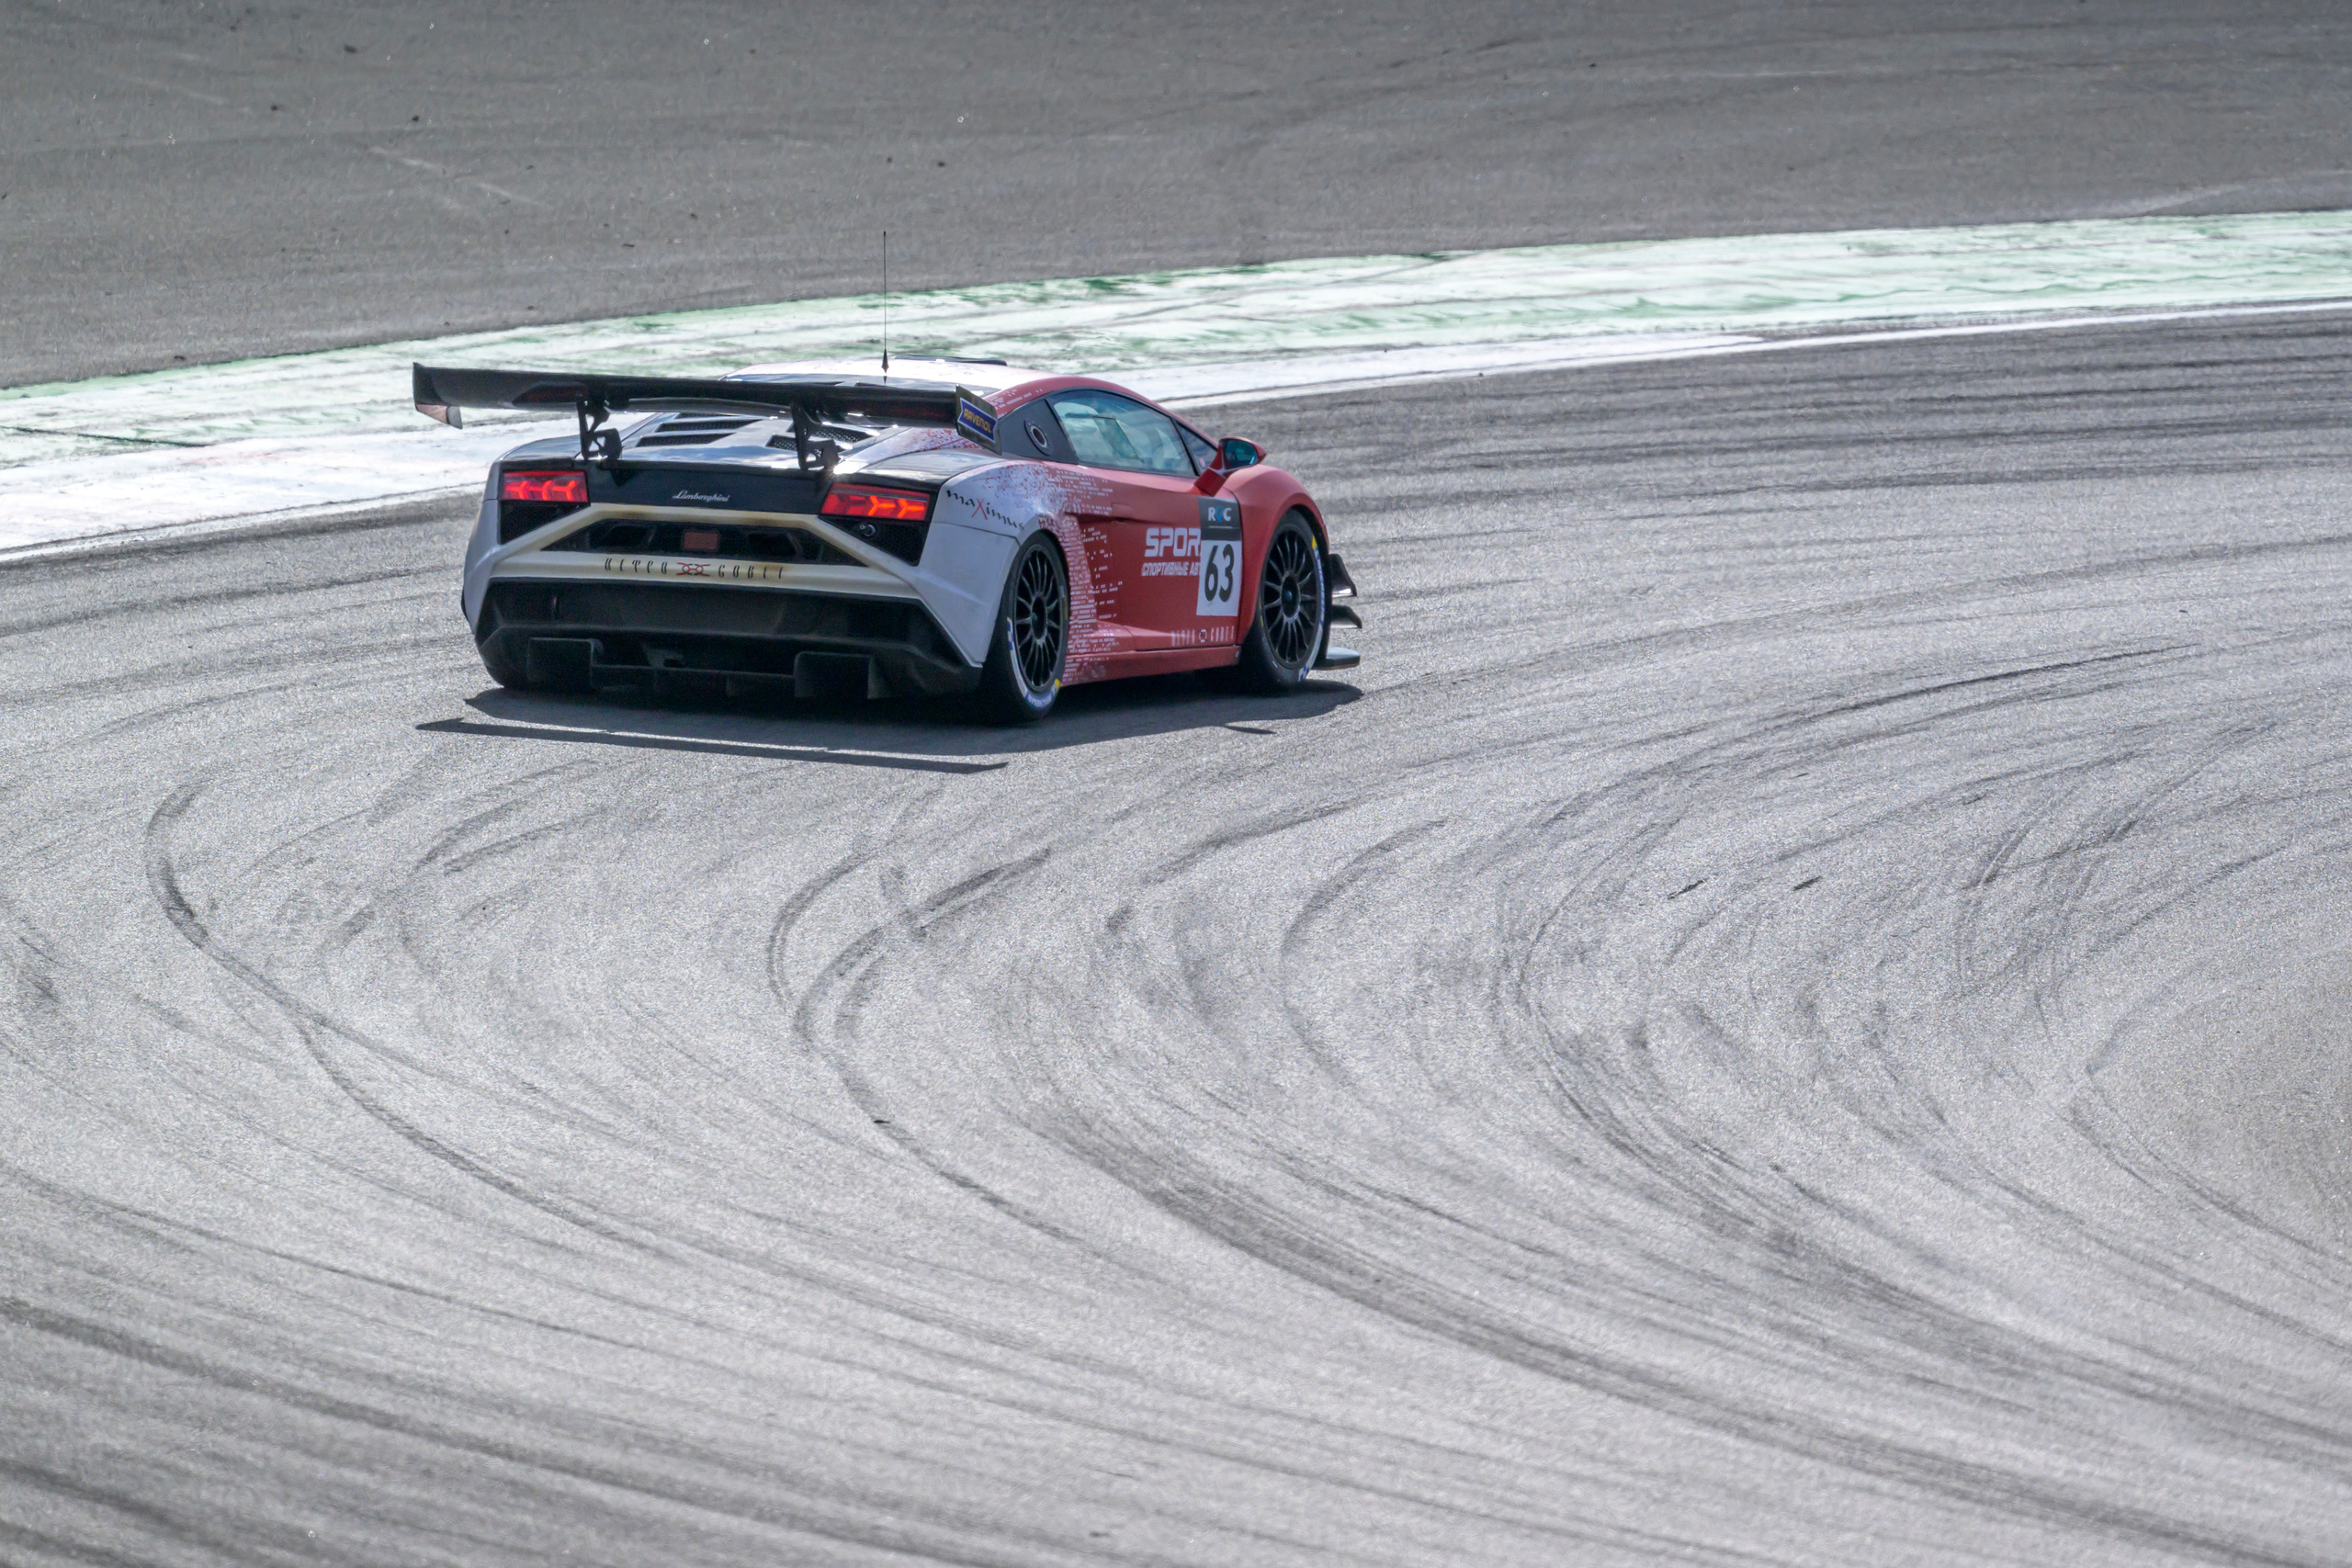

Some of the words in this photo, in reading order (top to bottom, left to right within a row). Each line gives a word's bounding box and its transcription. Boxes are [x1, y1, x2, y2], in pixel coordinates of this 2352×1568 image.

[963, 408, 992, 434] RAVENOL
[672, 489, 730, 502] Lamborghini
[1145, 527, 1202, 557] SPOR
[1189, 561, 1202, 577] АВ
[1204, 544, 1235, 603] 63
